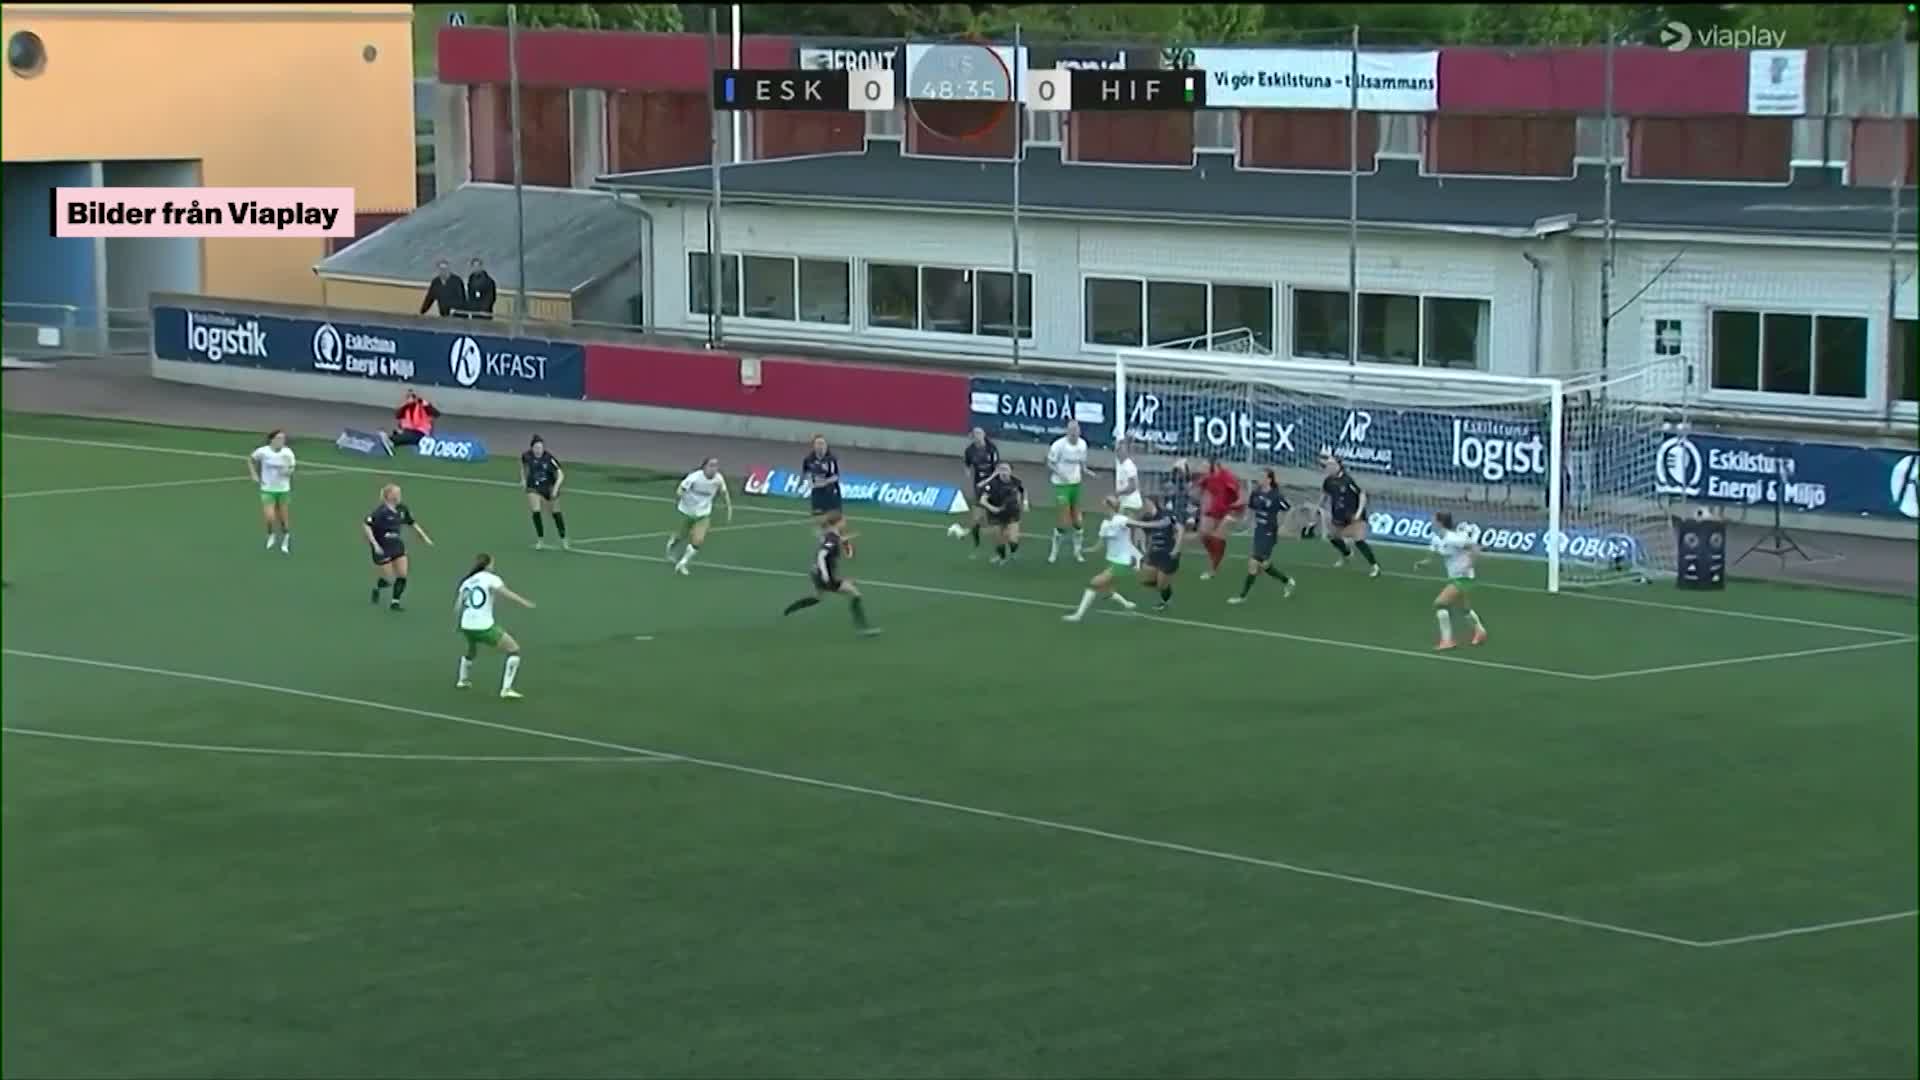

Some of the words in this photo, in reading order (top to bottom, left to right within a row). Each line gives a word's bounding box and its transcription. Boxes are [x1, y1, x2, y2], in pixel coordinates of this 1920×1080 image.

[1214, 72, 1229, 87] Vi
[1231, 71, 1254, 91] gör
[1258, 71, 1332, 89] Eskilstuna
[1344, 73, 1435, 91] tllsammans
[187, 311, 267, 361] logistik
[486, 353, 548, 381] KFAST
[1001, 393, 1072, 420] SANDÅ
[1453, 419, 1545, 480] logist
[1709, 448, 1796, 475] Eskilstuna
[1708, 476, 1762, 504] Energi
[1784, 482, 1827, 510] Miljö
[1481, 528, 1536, 551] OBOS
[463, 586, 487, 610] 20
